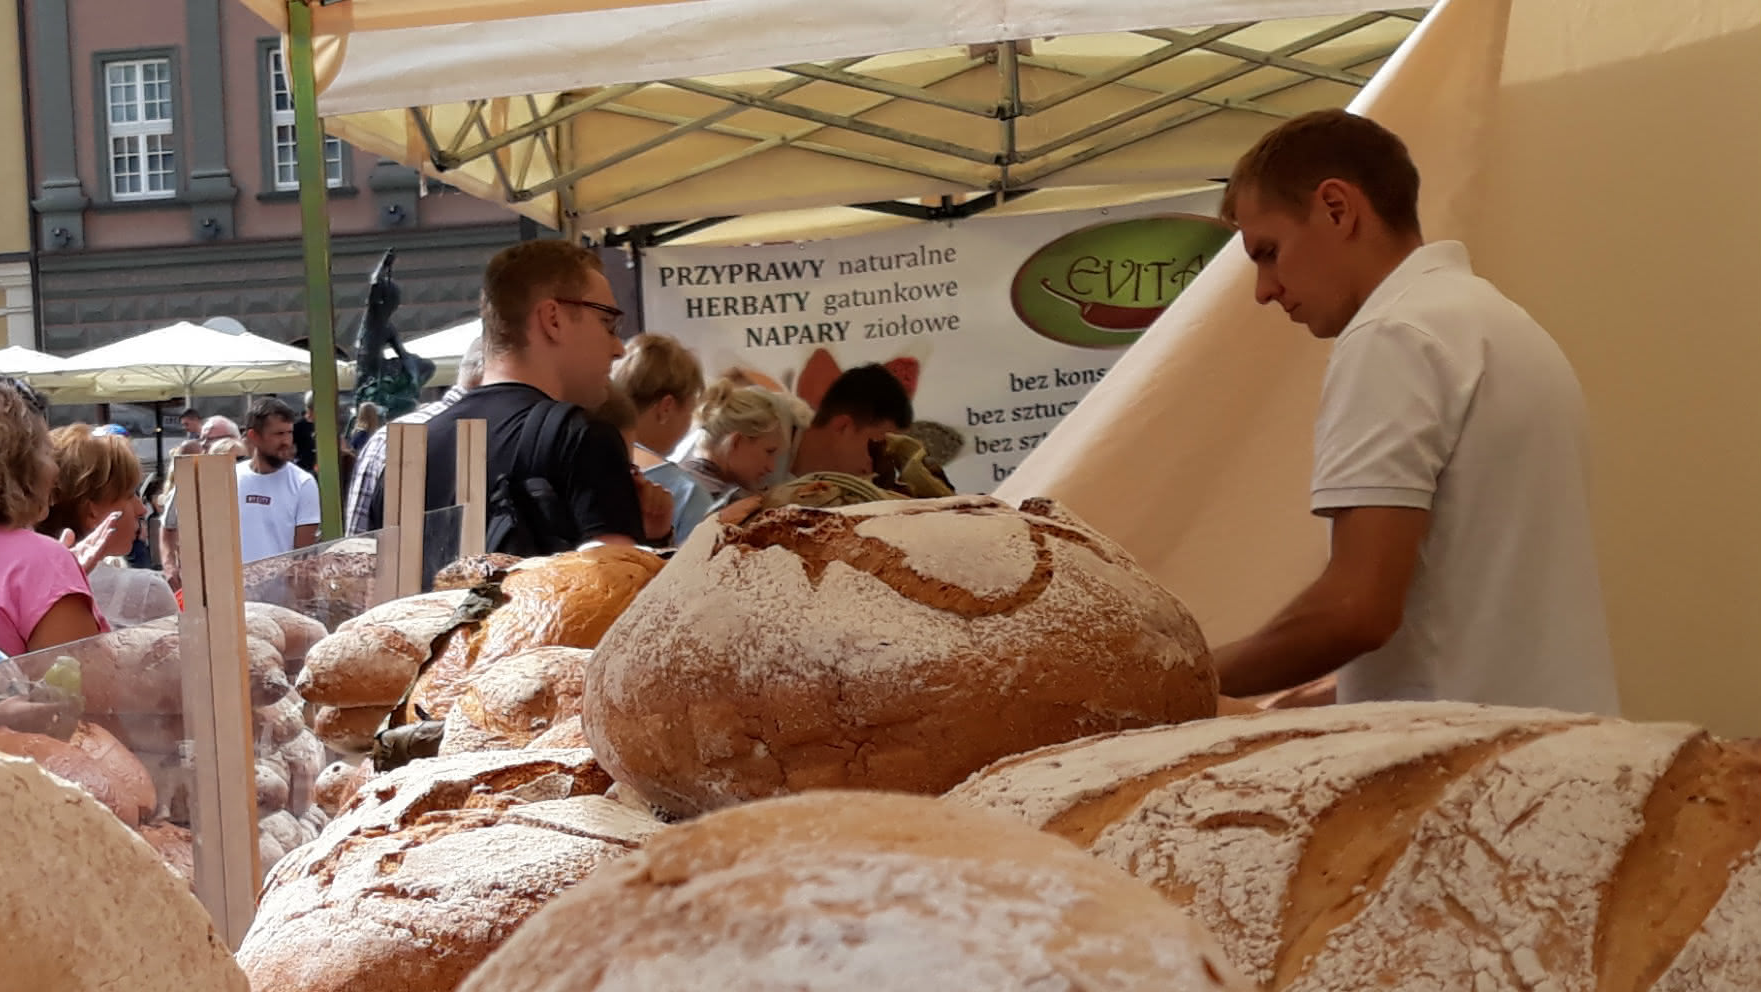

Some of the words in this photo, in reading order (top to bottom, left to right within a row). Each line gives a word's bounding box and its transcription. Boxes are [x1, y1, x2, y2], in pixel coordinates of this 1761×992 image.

[659, 259, 825, 288] PRZYPRAWY
[838, 245, 957, 275] naturalne
[1067, 254, 1205, 302] EVITA
[686, 291, 810, 319] HERBATY
[823, 280, 959, 315] gatunkowe
[746, 321, 851, 348] NAPARY
[864, 314, 961, 339] ziołowe
[1009, 372, 1049, 392] bez
[1054, 367, 1107, 388] kons
[966, 406, 1006, 426] bez
[974, 435, 1013, 455] bez
